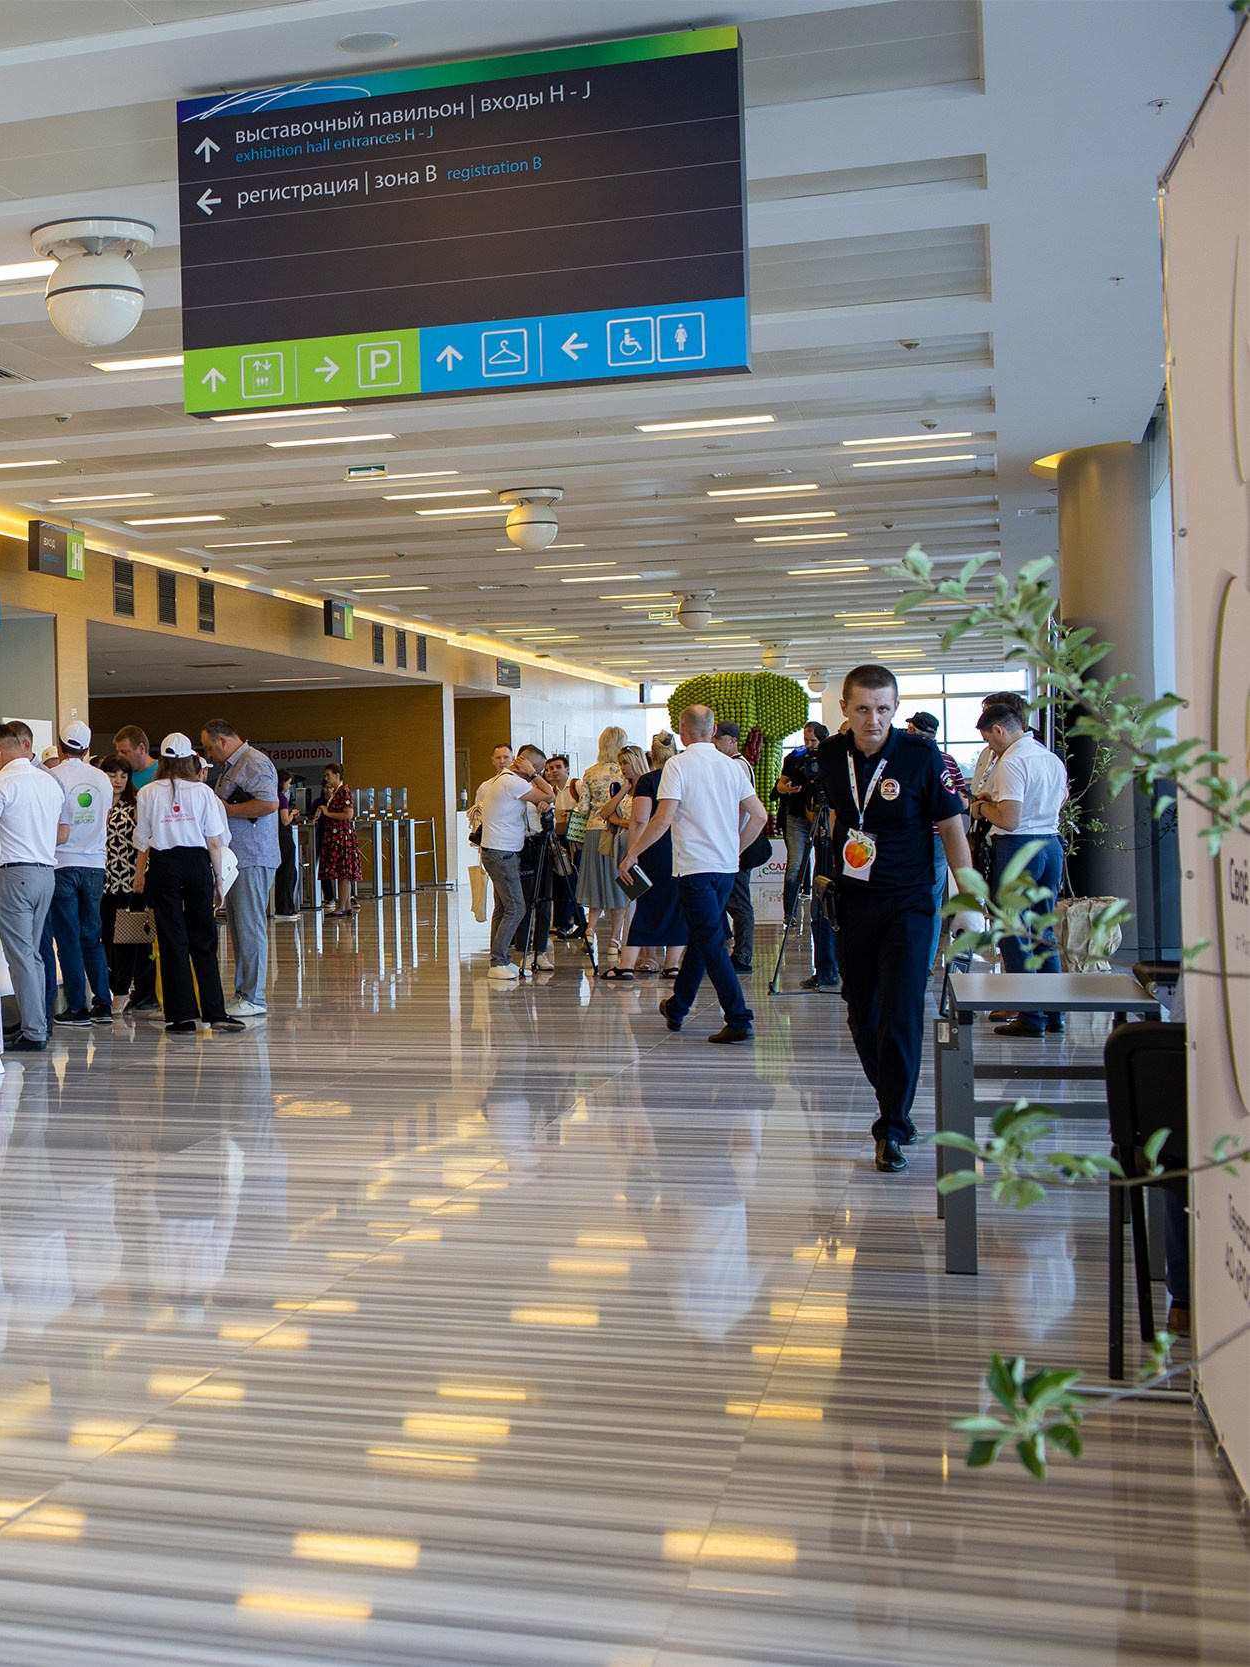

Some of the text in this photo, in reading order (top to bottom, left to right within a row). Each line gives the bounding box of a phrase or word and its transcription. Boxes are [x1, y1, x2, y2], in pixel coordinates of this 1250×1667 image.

[235, 111, 364, 144] выставочный
[369, 102, 464, 127] павильон
[480, 90, 544, 113] входы
[582, 81, 592, 99] J
[235, 144, 303, 163] exhibition
[306, 138, 330, 154] hall
[333, 131, 400, 151] entrances
[404, 128, 416, 142] H
[427, 125, 435, 140] J
[237, 177, 359, 208] регистрация
[374, 170, 420, 190] зона
[447, 160, 529, 182] registration
[533, 155, 543, 171] B
[370, 349, 392, 381] P
